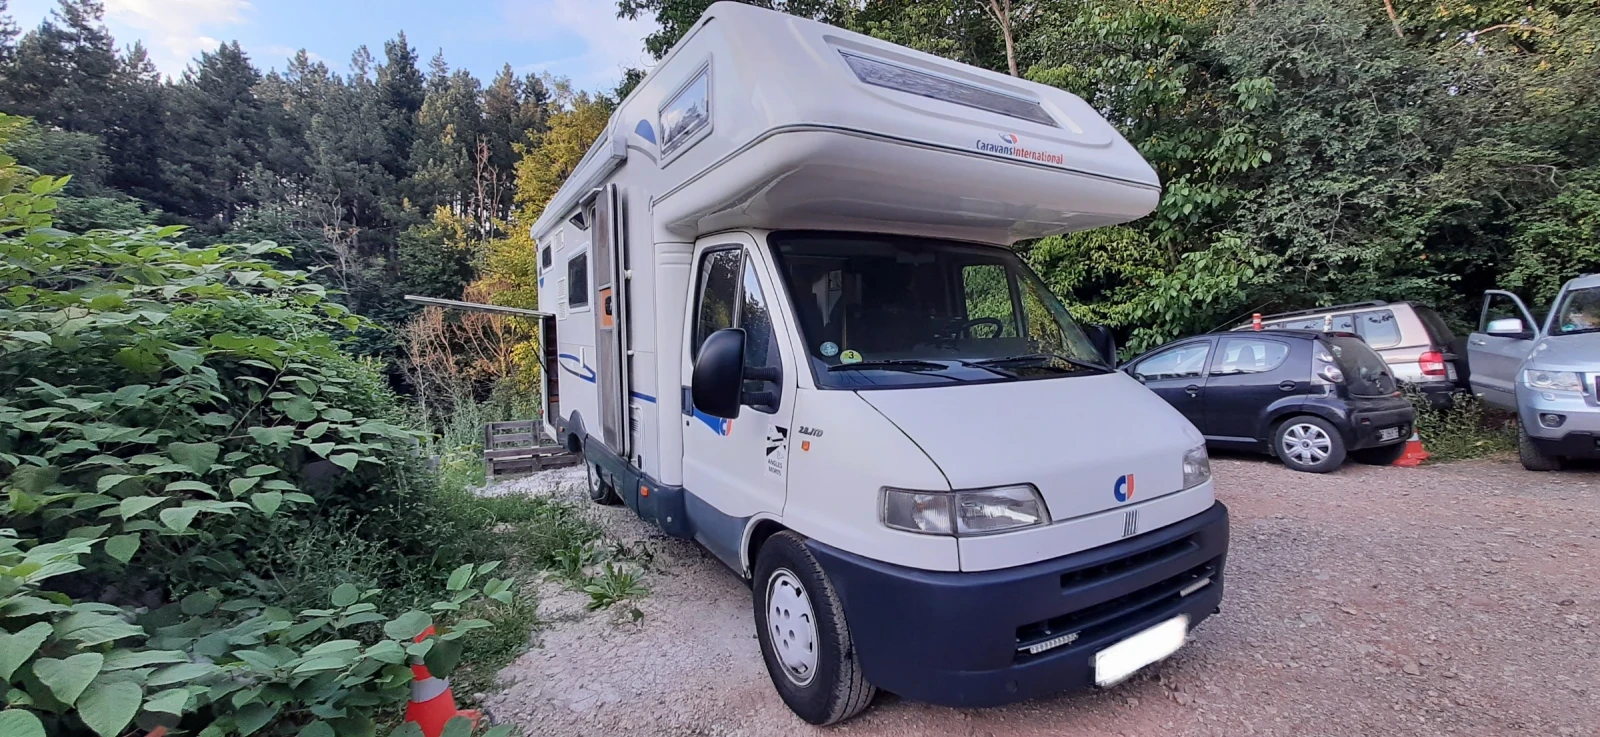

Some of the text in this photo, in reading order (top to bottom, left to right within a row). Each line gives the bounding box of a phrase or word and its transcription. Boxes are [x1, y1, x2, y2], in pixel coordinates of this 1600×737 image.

[848, 351, 854, 359] 3
[768, 458, 783, 469] ANGLES
[768, 466, 782, 476] MORTS
